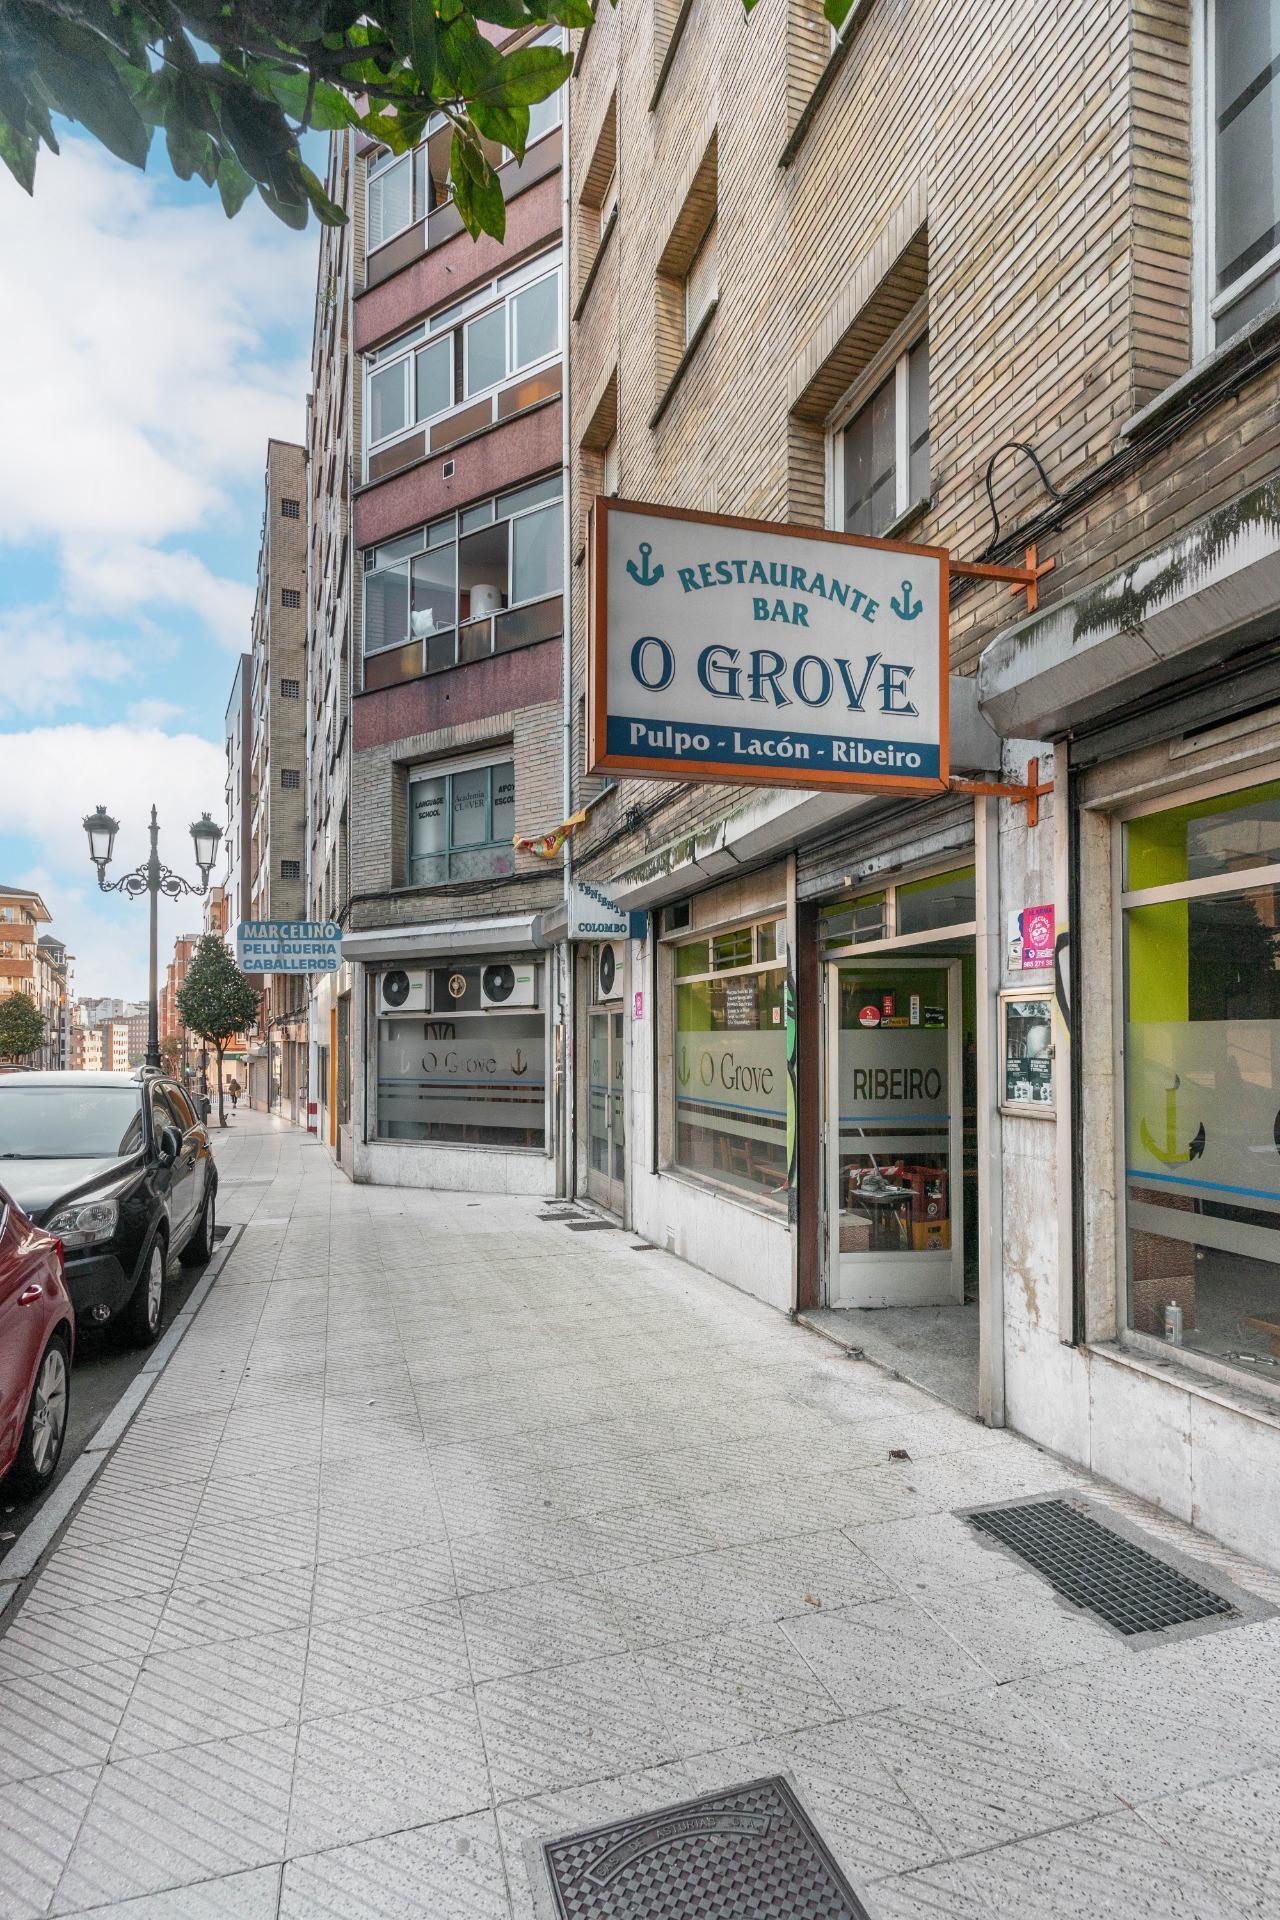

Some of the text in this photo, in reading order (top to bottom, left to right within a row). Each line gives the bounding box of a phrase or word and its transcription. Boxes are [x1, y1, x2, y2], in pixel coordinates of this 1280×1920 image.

[678, 560, 880, 624] RESTAURANTE
[752, 597, 810, 627] BAR
[630, 636, 919, 717] O GROVE
[630, 723, 710, 755] Pulpo
[734, 731, 810, 759] Lacón
[832, 741, 921, 768] Ribeiro
[415, 797, 444, 809] LANGUAGE
[454, 799, 485, 812] CLVER
[418, 809, 440, 820] SCHOOL
[244, 924, 335, 939] MARCELINO
[578, 923, 627, 933] COLOMBO
[243, 943, 337, 954] PELUQUERIA
[243, 959, 337, 970] CABALLEROS
[422, 1052, 497, 1073] O Gove
[700, 1052, 773, 1095] O Grove
[853, 1067, 942, 1100] RIBEIRO
[656, 1816, 717, 1838] ASTURIAS
